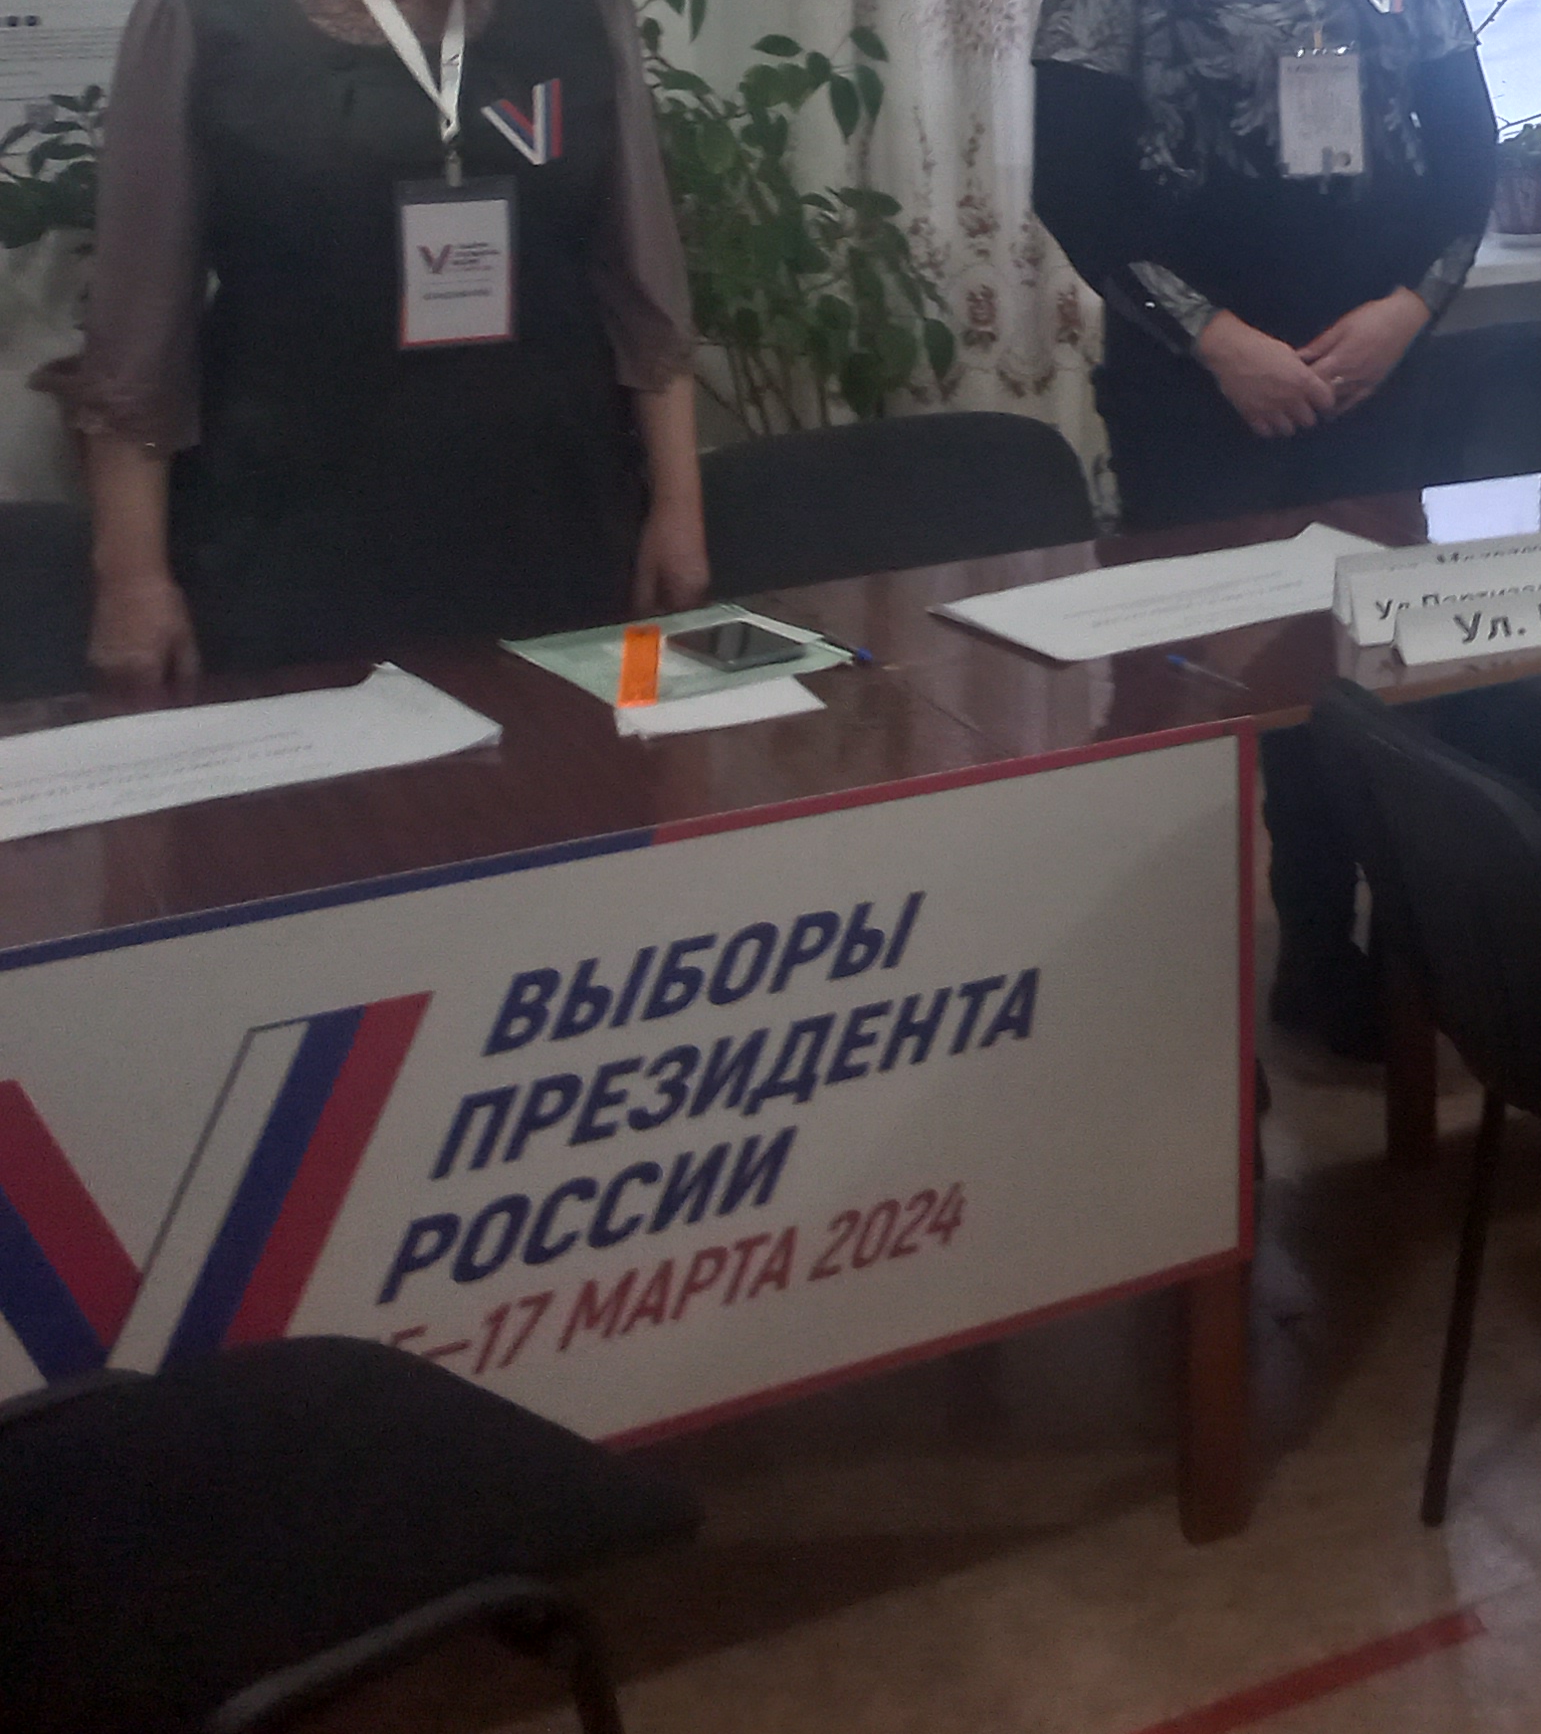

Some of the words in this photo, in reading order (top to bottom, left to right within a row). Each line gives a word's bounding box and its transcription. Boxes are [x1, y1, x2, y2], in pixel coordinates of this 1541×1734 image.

[1453, 611, 1526, 644] Ул.
[481, 891, 926, 1057] ВЫБОРЫ
[430, 967, 1040, 1180] ПРЕЗИДЕНТА
[375, 1126, 797, 1305] РОССИИ
[558, 1225, 798, 1352] МАРТА
[806, 1181, 968, 1283] 2024
